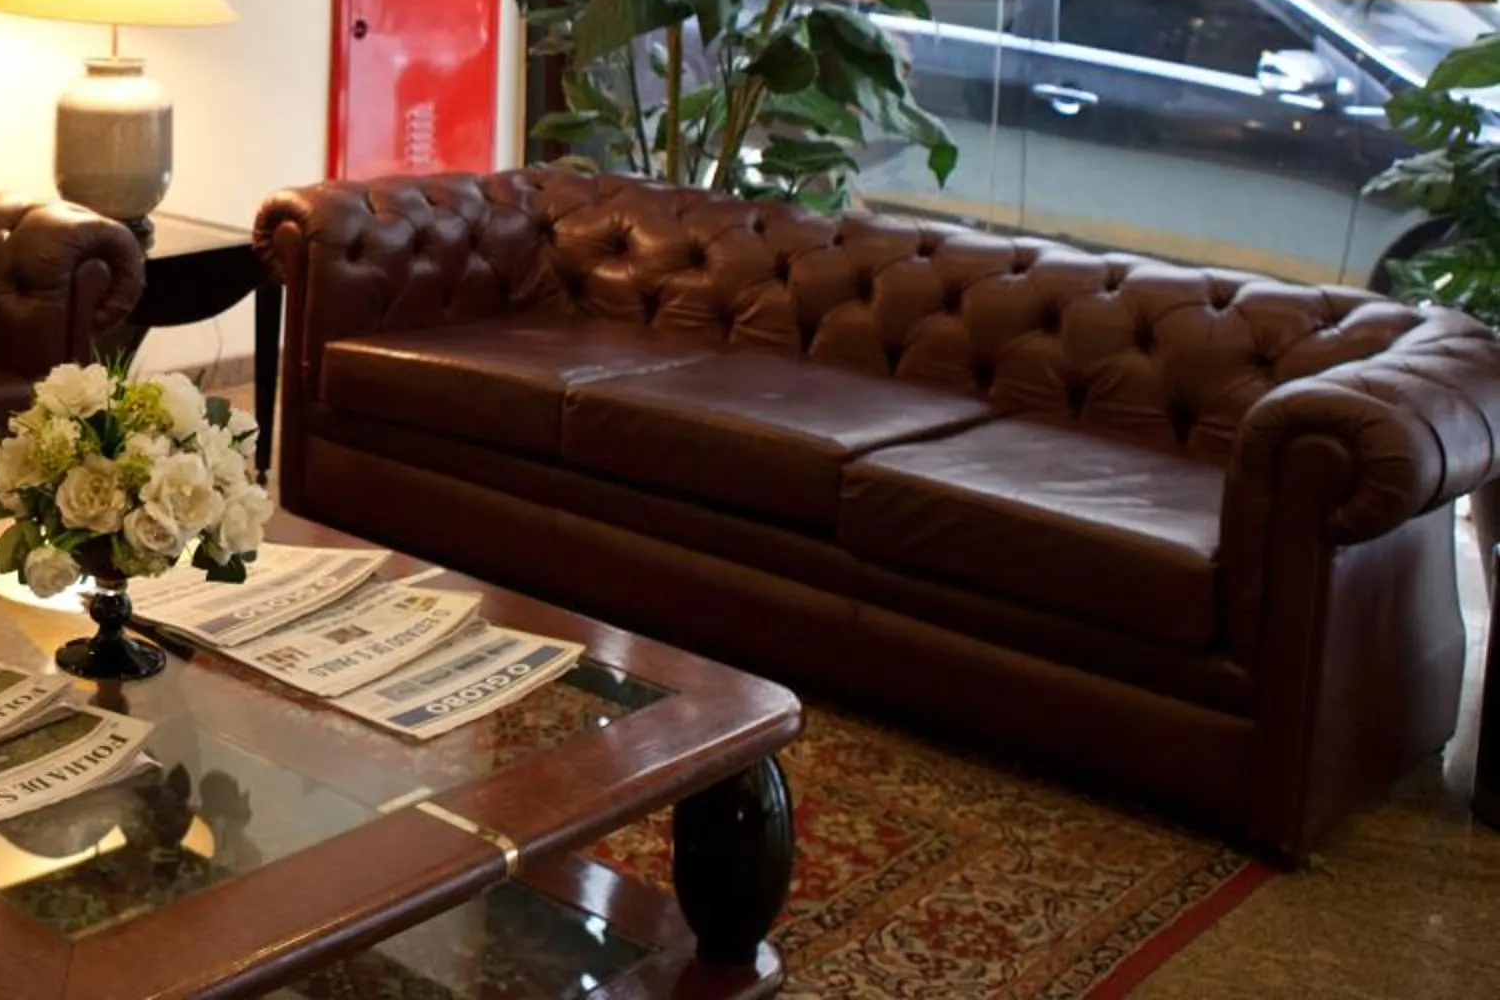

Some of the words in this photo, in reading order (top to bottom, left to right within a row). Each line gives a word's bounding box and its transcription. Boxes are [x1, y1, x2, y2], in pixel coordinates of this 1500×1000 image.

[507, 663, 531, 676] O
[425, 674, 511, 714] GLOBO
[45, 732, 129, 782] FOLHA
[18, 776, 53, 794] DE
